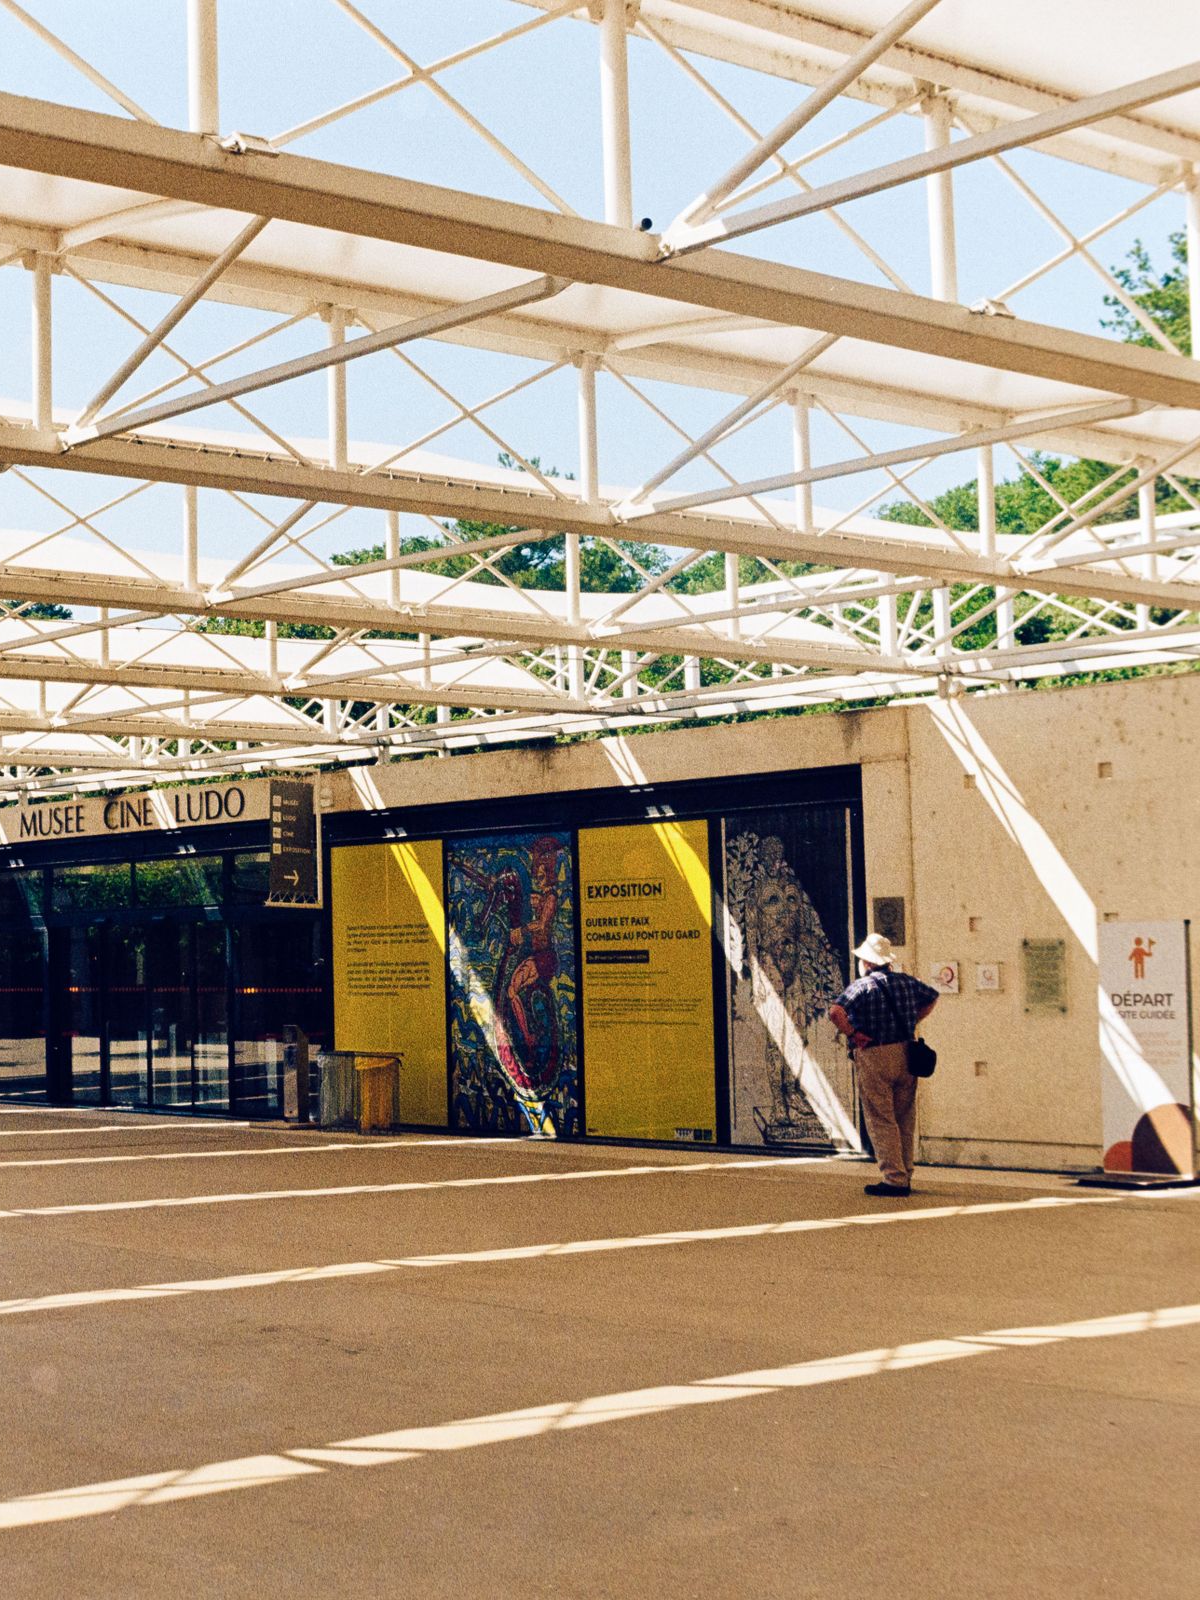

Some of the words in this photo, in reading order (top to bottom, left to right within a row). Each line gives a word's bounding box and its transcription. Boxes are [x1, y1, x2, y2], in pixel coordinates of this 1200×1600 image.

[20, 805, 85, 838] MUSEE
[103, 798, 153, 830] CINE
[175, 787, 245, 823] LUDO
[587, 883, 662, 898] EXPOSITION
[586, 917, 617, 927] GUERRE
[620, 917, 629, 926] ET
[631, 917, 649, 926] PAIX
[586, 932, 620, 941] COMBAS
[623, 932, 634, 940] AU
[636, 931, 659, 940] PONT
[661, 931, 674, 939] DU
[675, 930, 700, 939] GARD
[1111, 990, 1173, 1007] DÉPART
[1114, 1010, 1138, 1020] SITE
[1139, 1010, 1176, 1020] GUIDÉE
